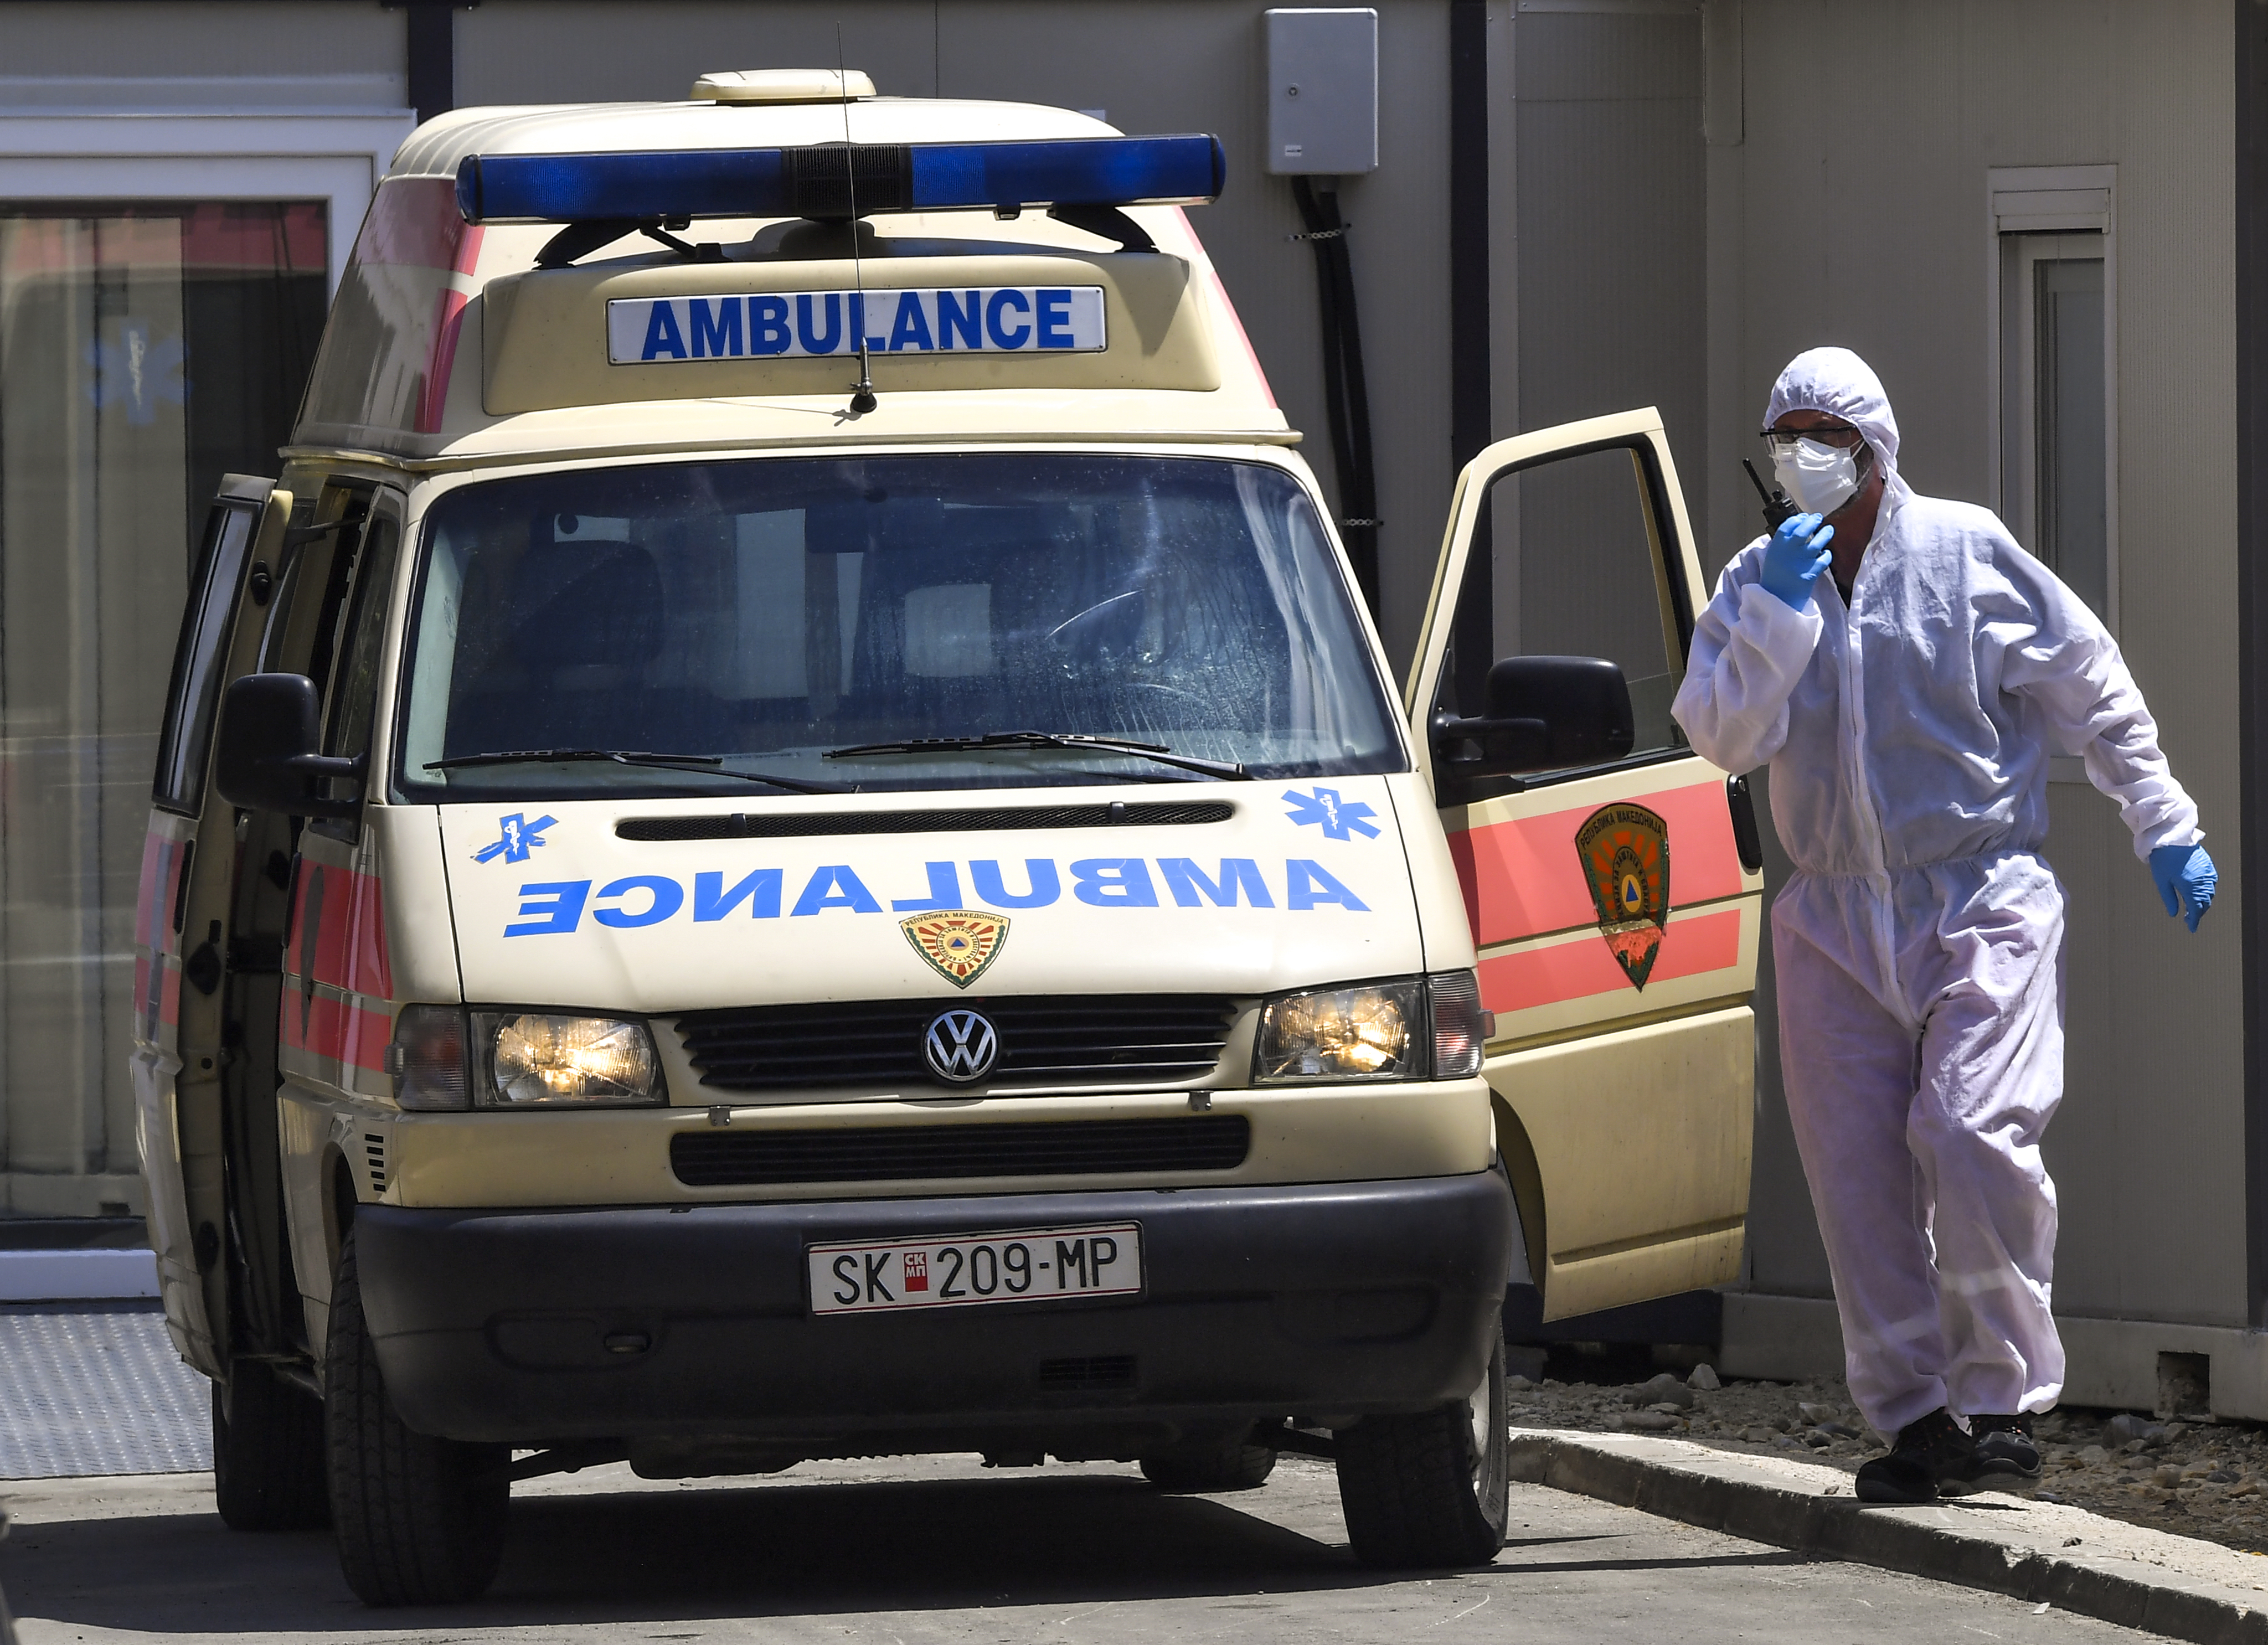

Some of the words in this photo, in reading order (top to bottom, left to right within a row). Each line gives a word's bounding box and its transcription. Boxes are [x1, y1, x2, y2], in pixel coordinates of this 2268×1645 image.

[641, 288, 1074, 360] AMBULANCE
[1580, 812, 1615, 850] РЕПУБЛИКА
[1616, 811, 1662, 837] МАКЕДОНИЈА
[905, 913, 950, 926] РЕПУБЛИКА
[952, 912, 1003, 924] МАКЕДОНИЈА
[833, 1252, 895, 1304] SK
[906, 1265, 926, 1278] МП
